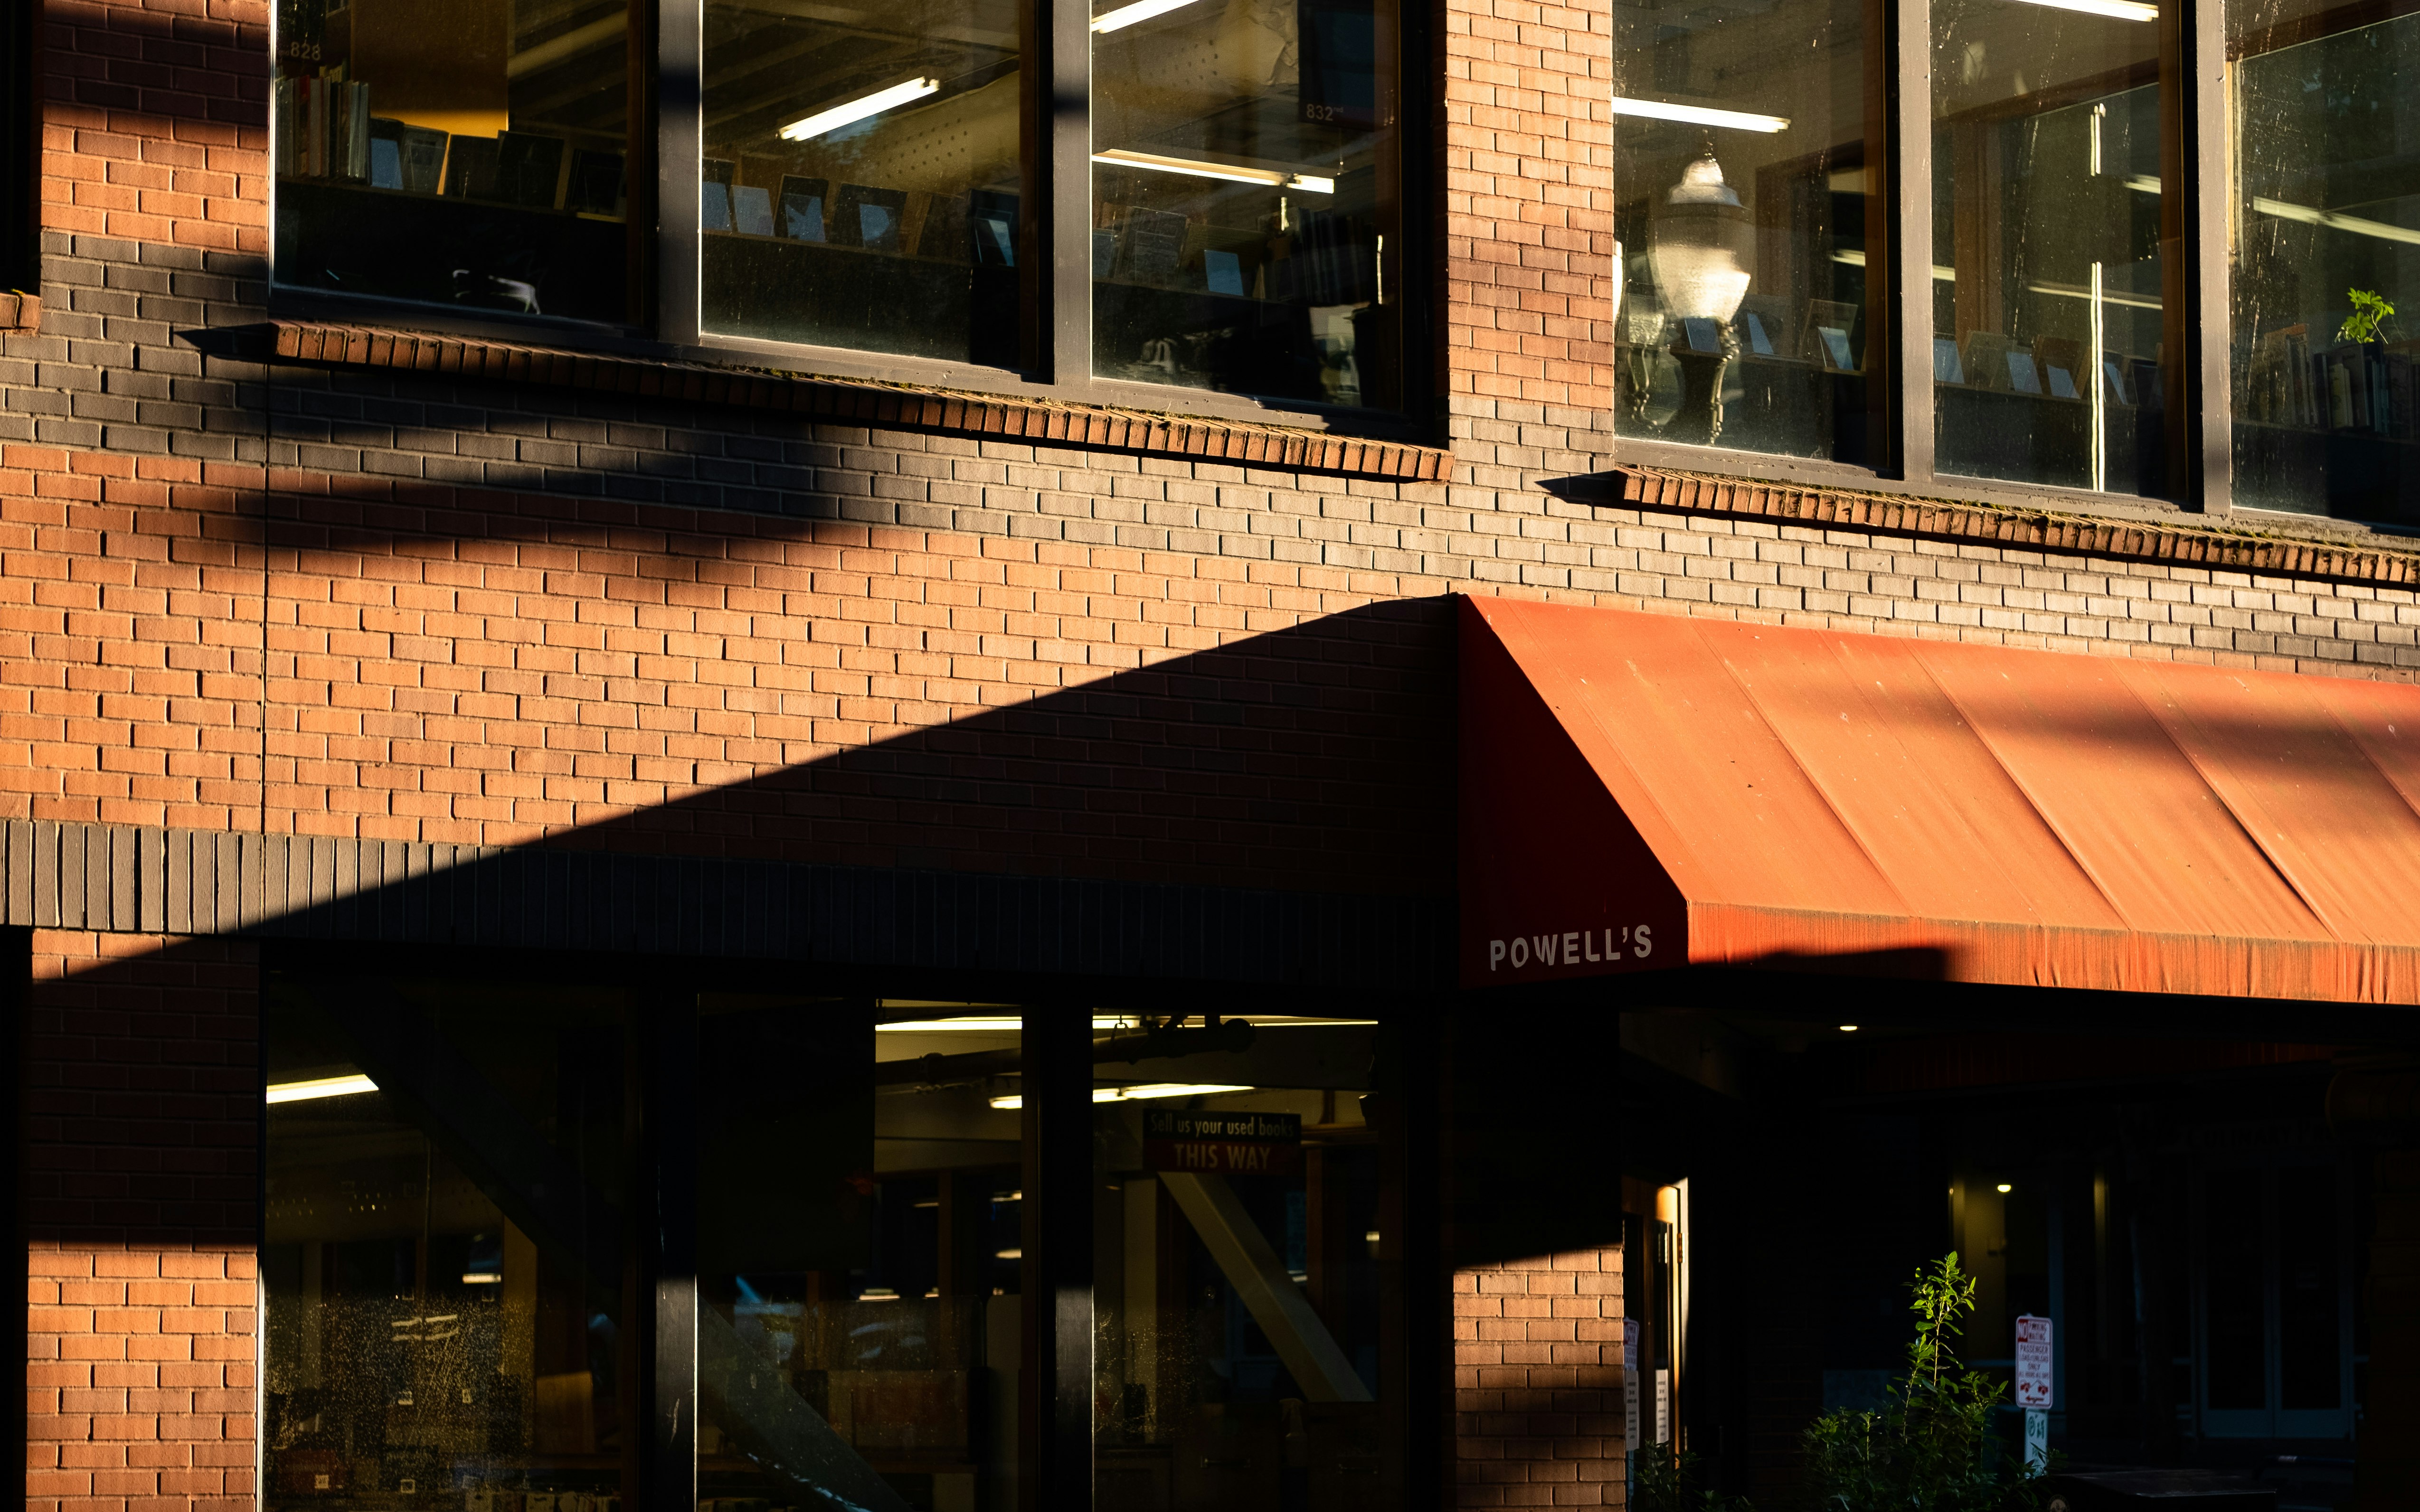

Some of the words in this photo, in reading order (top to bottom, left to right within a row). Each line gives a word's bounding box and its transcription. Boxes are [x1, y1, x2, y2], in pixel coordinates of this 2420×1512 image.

[290, 41, 321, 61] 828
[1306, 103, 1333, 122] 832
[1490, 924, 1652, 971] POWELL'S
[1150, 1113, 1173, 1133] Sell
[1177, 1119, 1191, 1133] us
[1195, 1120, 1223, 1138] your
[1227, 1116, 1255, 1136] used
[1258, 1116, 1295, 1137] books
[1174, 1143, 1218, 1169] THIS
[1226, 1145, 1271, 1170] WAY
